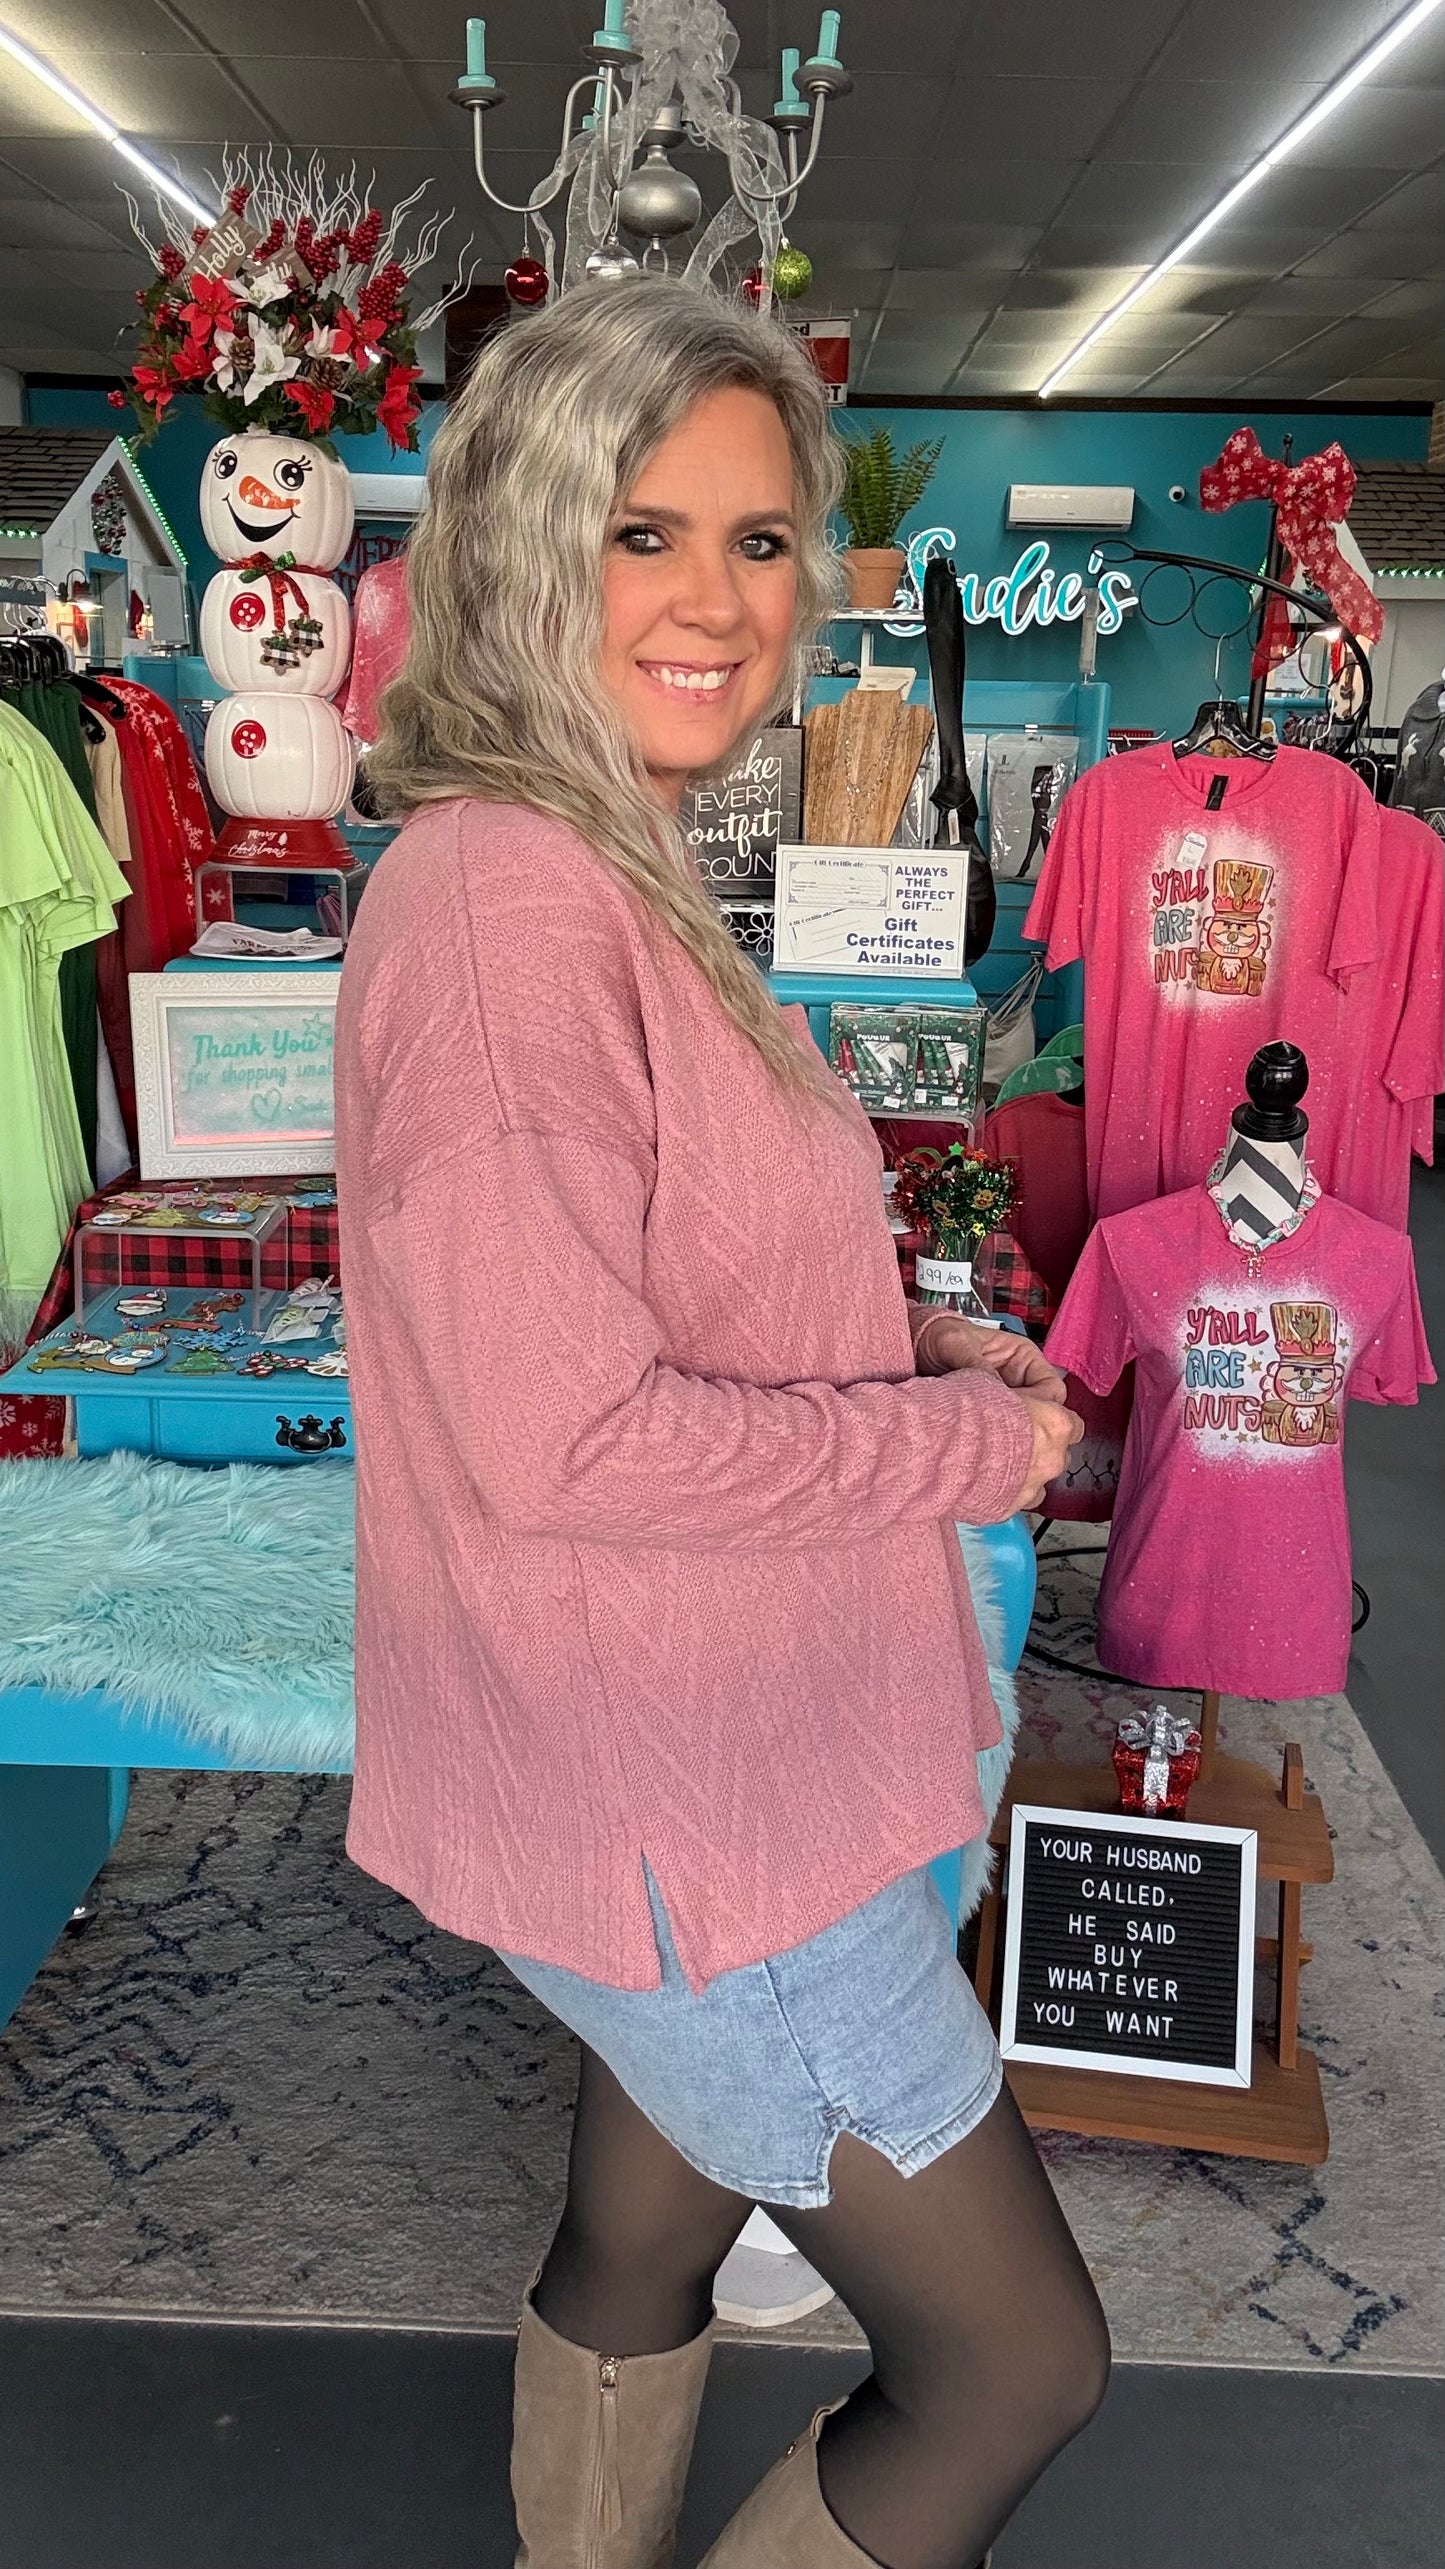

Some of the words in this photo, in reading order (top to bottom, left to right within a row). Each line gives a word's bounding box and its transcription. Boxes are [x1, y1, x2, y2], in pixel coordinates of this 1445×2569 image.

[698, 784, 779, 812] EVERY
[687, 808, 783, 858] outfit
[694, 853, 778, 880] COUN
[895, 866, 948, 877] ALWAYS
[896, 889, 955, 901] PERFECT
[905, 878, 931, 888] THE
[1152, 868, 1209, 907] Y'ALL
[902, 901, 943, 912] GIFT...
[884, 917, 918, 933] Gift
[1154, 909, 1195, 946] ARE
[846, 933, 955, 951] Certificates
[857, 950, 942, 966] Available
[192, 1033, 266, 1065] Thank
[272, 1030, 320, 1059] You
[181, 1065, 210, 1094] for
[221, 1061, 287, 1090] shopping
[1186, 1305, 1269, 1346] Y'ALL
[1186, 1349, 1246, 1389] ARE
[1184, 1393, 1263, 1432] NUTS
[1040, 1837, 1093, 1864] YOUR
[1107, 1845, 1202, 1874] HUSBAND
[1081, 1878, 1175, 1907] CALLED,
[1068, 1914, 1097, 1936] HE
[1126, 1920, 1176, 1944] SAID
[1094, 1944, 1142, 1969] BUY
[1048, 1966, 1178, 2002] WHATEVER
[1033, 2002, 1075, 2027] YOU
[1106, 2010, 1174, 2039] WANT
